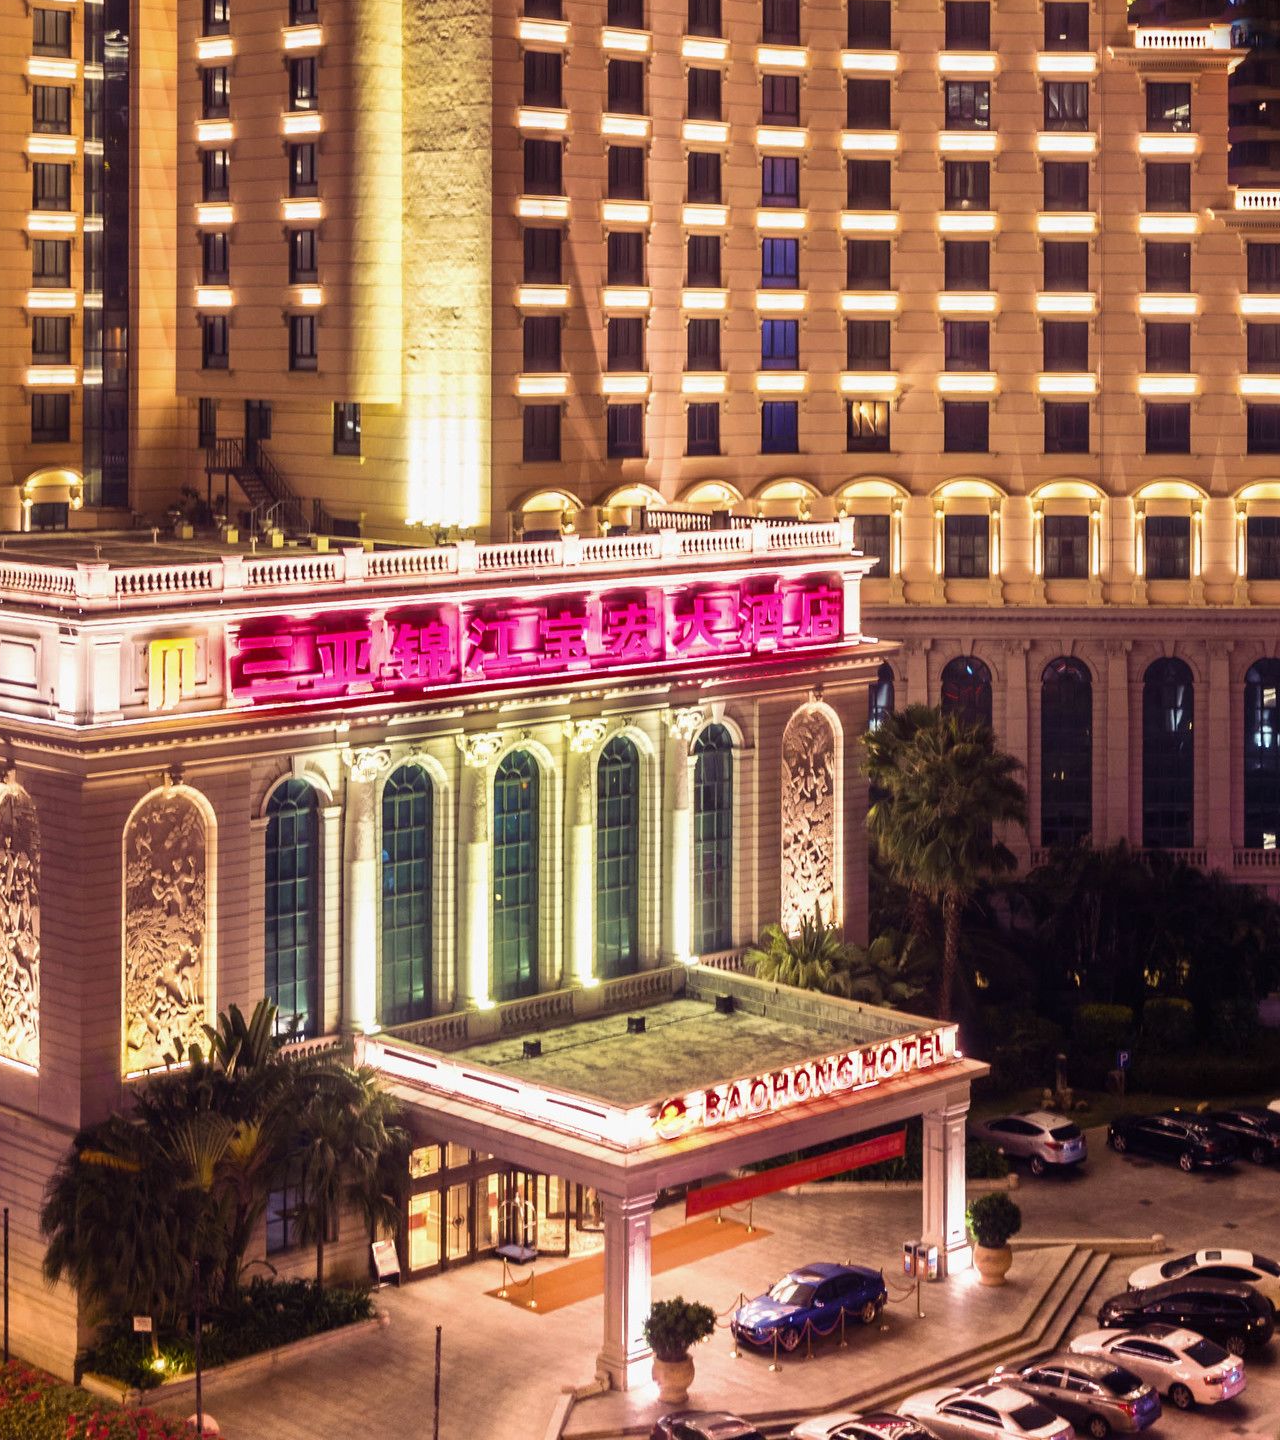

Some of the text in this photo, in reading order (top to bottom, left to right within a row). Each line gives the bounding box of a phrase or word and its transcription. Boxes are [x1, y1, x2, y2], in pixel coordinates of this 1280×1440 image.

[233, 586, 841, 698] 三亚锦江宝宏大酒店
[703, 1034, 948, 1127] BAOHONG HOTEL
[1120, 1053, 1129, 1067] P
